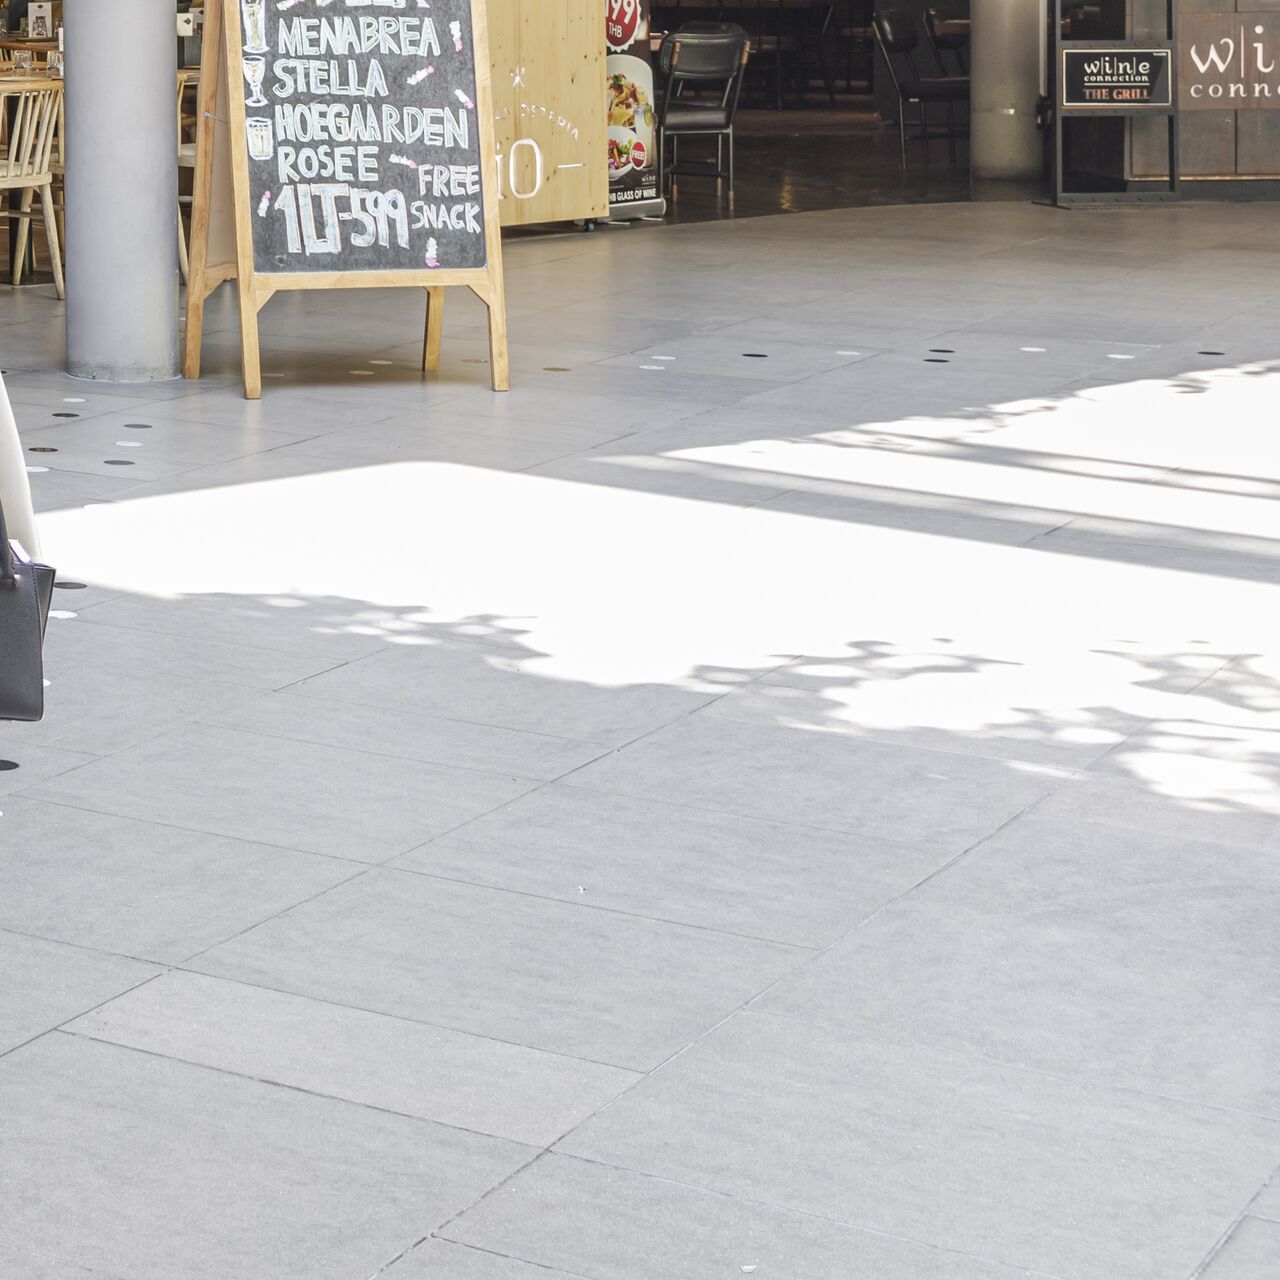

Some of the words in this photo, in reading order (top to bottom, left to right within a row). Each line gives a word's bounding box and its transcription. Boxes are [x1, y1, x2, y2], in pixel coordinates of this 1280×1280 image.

[278, 16, 440, 57] MENABREA
[608, 22, 623, 38] THB
[272, 58, 389, 97] STELLA
[1084, 74, 1149, 82] connection
[1190, 82, 1280, 98] conn
[1083, 89, 1109, 100] THE
[1112, 89, 1150, 100] GRILL
[274, 103, 469, 149] HOEGAARDEN
[277, 145, 379, 183] ROSEE
[418, 164, 481, 197] FREE
[617, 190, 634, 201] GLASS
[635, 190, 642, 199] OF
[643, 188, 656, 198] WINE
[410, 200, 481, 234] SNACK
